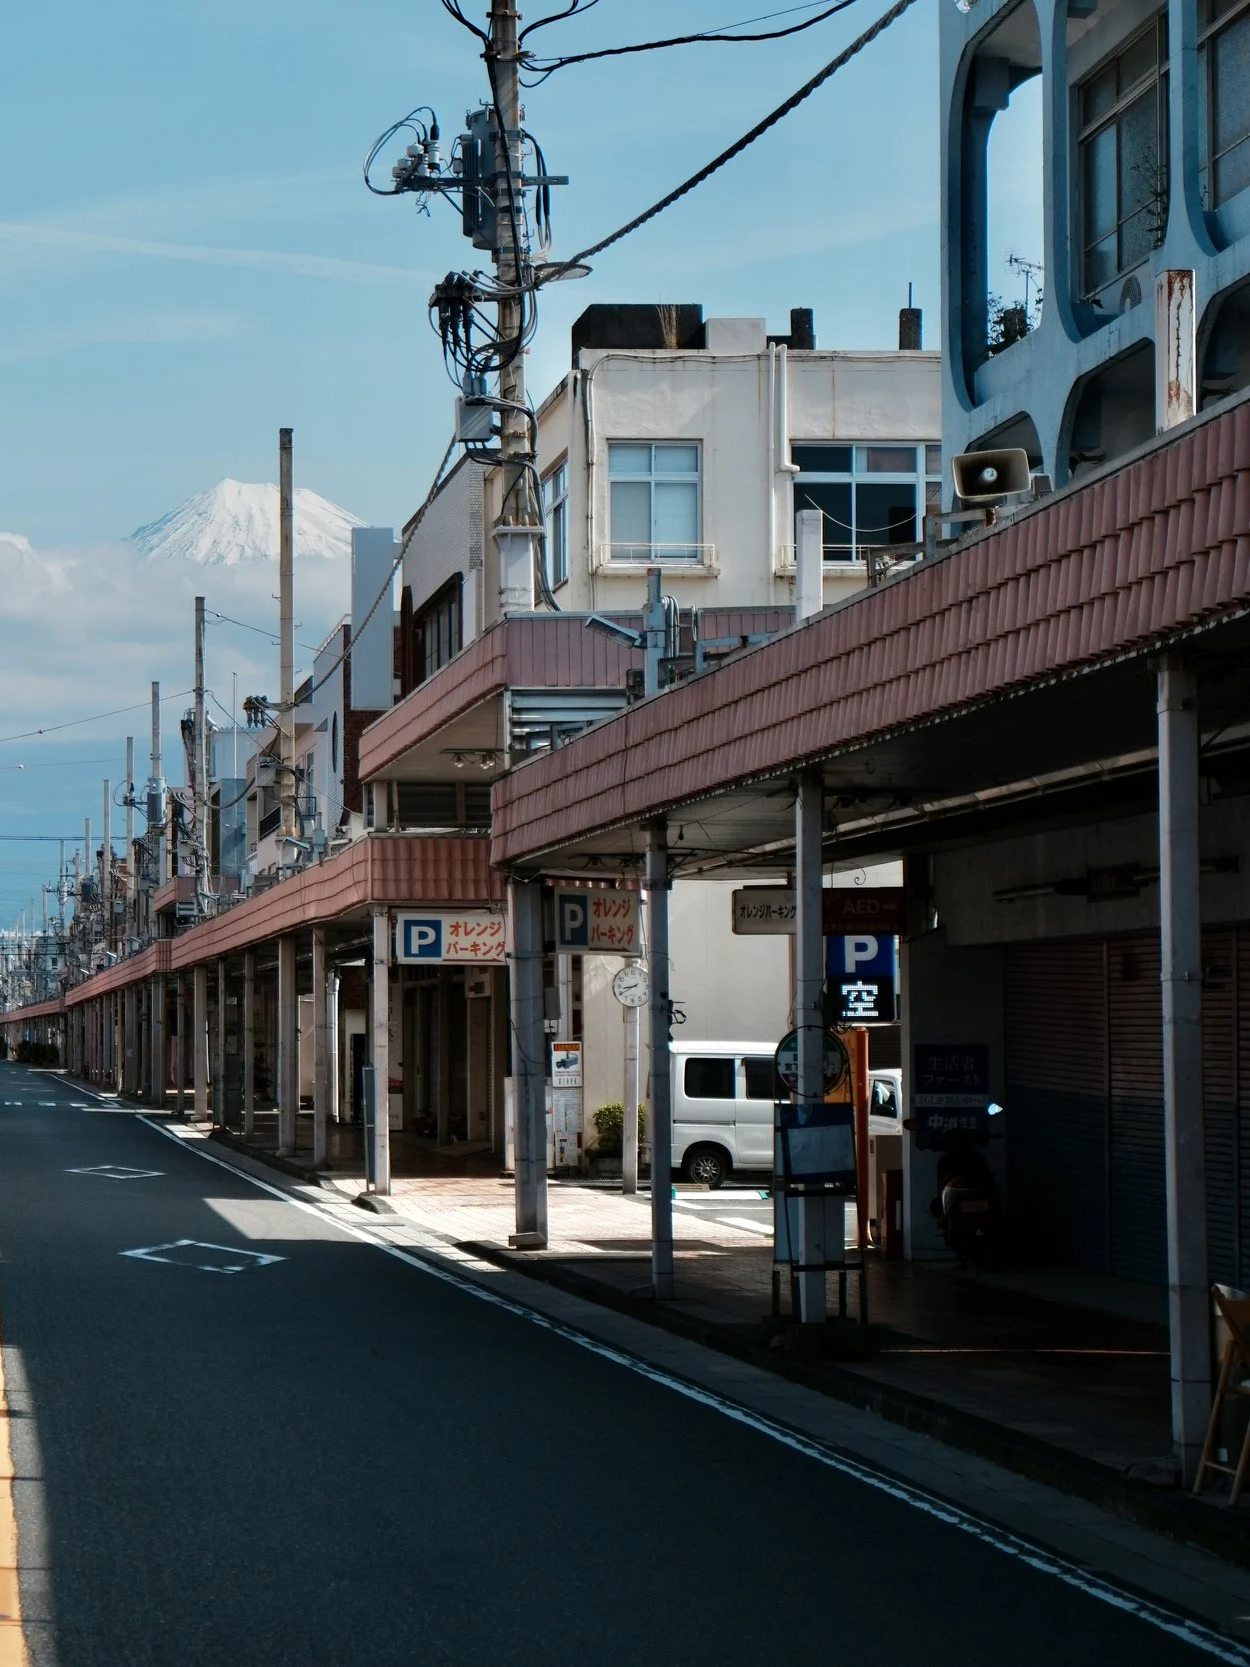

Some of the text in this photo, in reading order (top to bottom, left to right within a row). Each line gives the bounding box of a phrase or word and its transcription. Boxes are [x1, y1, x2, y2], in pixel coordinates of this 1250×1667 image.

[593, 897, 631, 918] オレンジ
[843, 900, 880, 914] AED
[450, 921, 502, 937] オレンジ
[564, 903, 584, 940] P
[411, 926, 436, 954] P
[446, 941, 506, 957] パーキング
[844, 935, 879, 973] P
[841, 981, 879, 1017] 空
[925, 1054, 975, 1071] 生活者
[922, 1073, 982, 1087] ファースト
